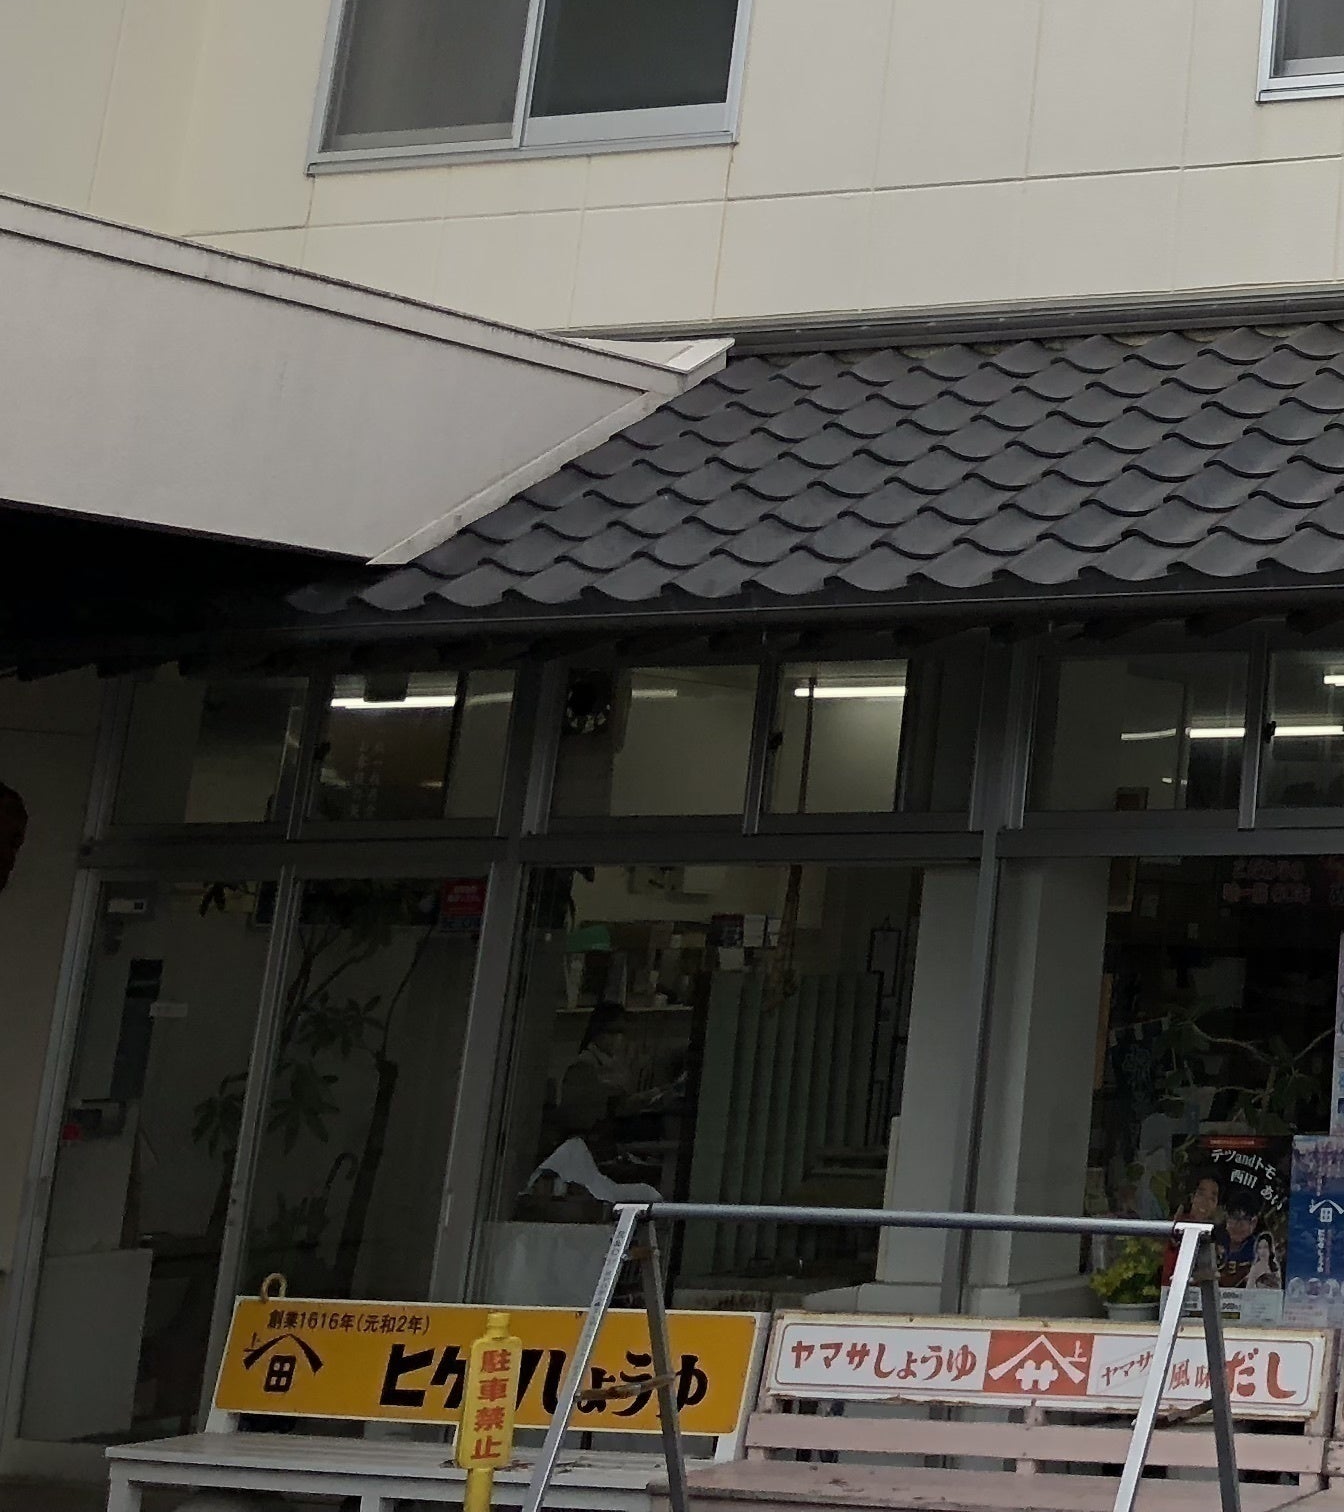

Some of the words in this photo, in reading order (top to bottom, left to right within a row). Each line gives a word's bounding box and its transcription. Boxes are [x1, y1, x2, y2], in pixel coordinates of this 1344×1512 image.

[1211, 1148, 1277, 1180] テツandトモ
[266, 1309, 431, 1335] 創業1616年(元和2年)
[791, 1339, 977, 1382] ヤマサしょうゆ
[1101, 1350, 1155, 1387] ヤマサ
[470, 1348, 512, 1460] 駐車禁止
